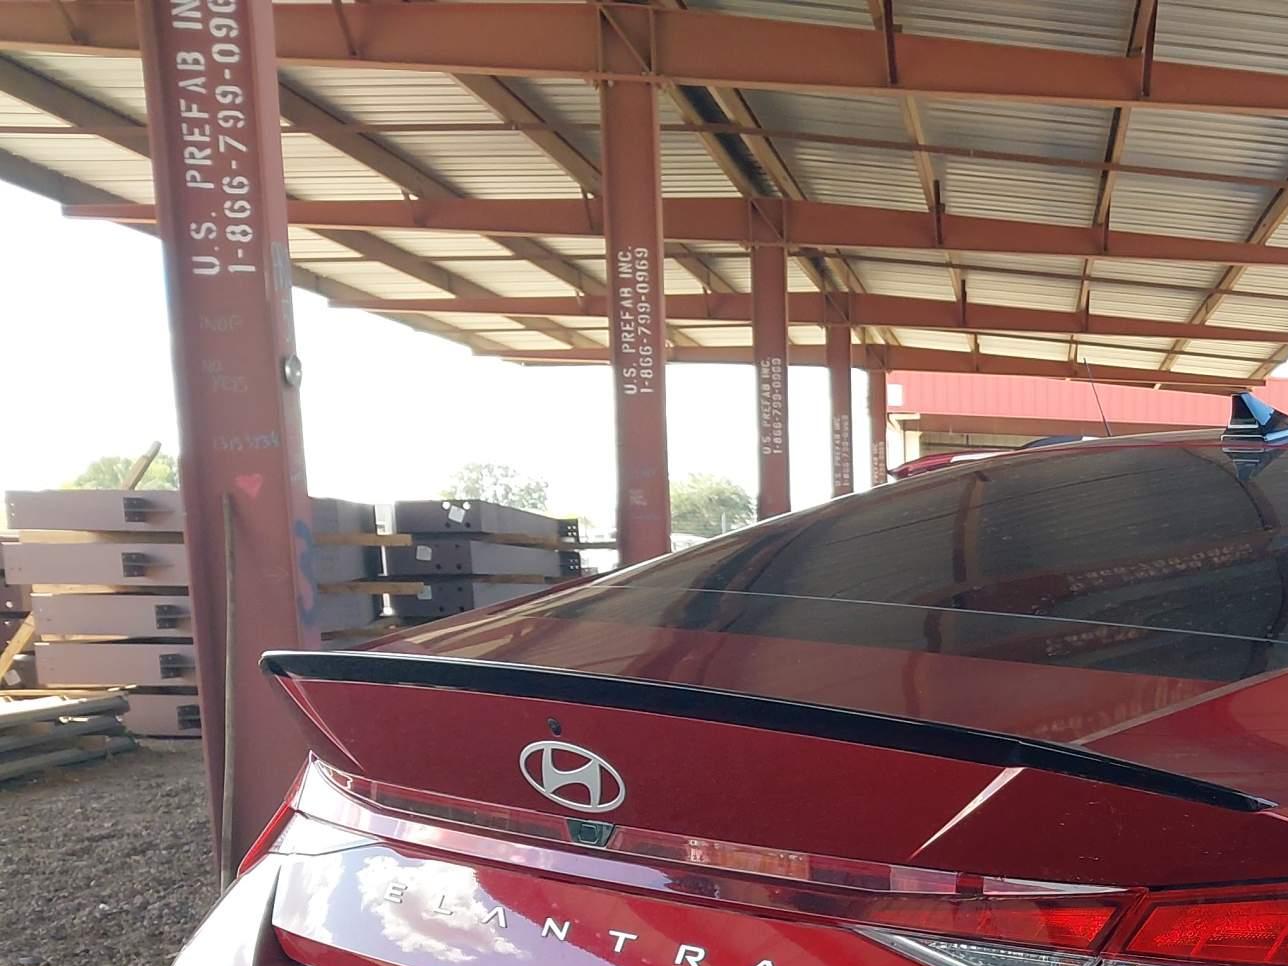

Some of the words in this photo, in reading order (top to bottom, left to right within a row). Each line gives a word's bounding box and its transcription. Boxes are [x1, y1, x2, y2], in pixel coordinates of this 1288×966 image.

[176, 51, 215, 189] PREFAB
[190, 211, 221, 275] U.S.
[617, 246, 634, 279] INC.
[619, 287, 636, 354] PREFAB
[634, 247, 654, 393] 1-866-799-0969
[623, 362, 638, 395] U.S.
[760, 384, 772, 428] PREFAB
